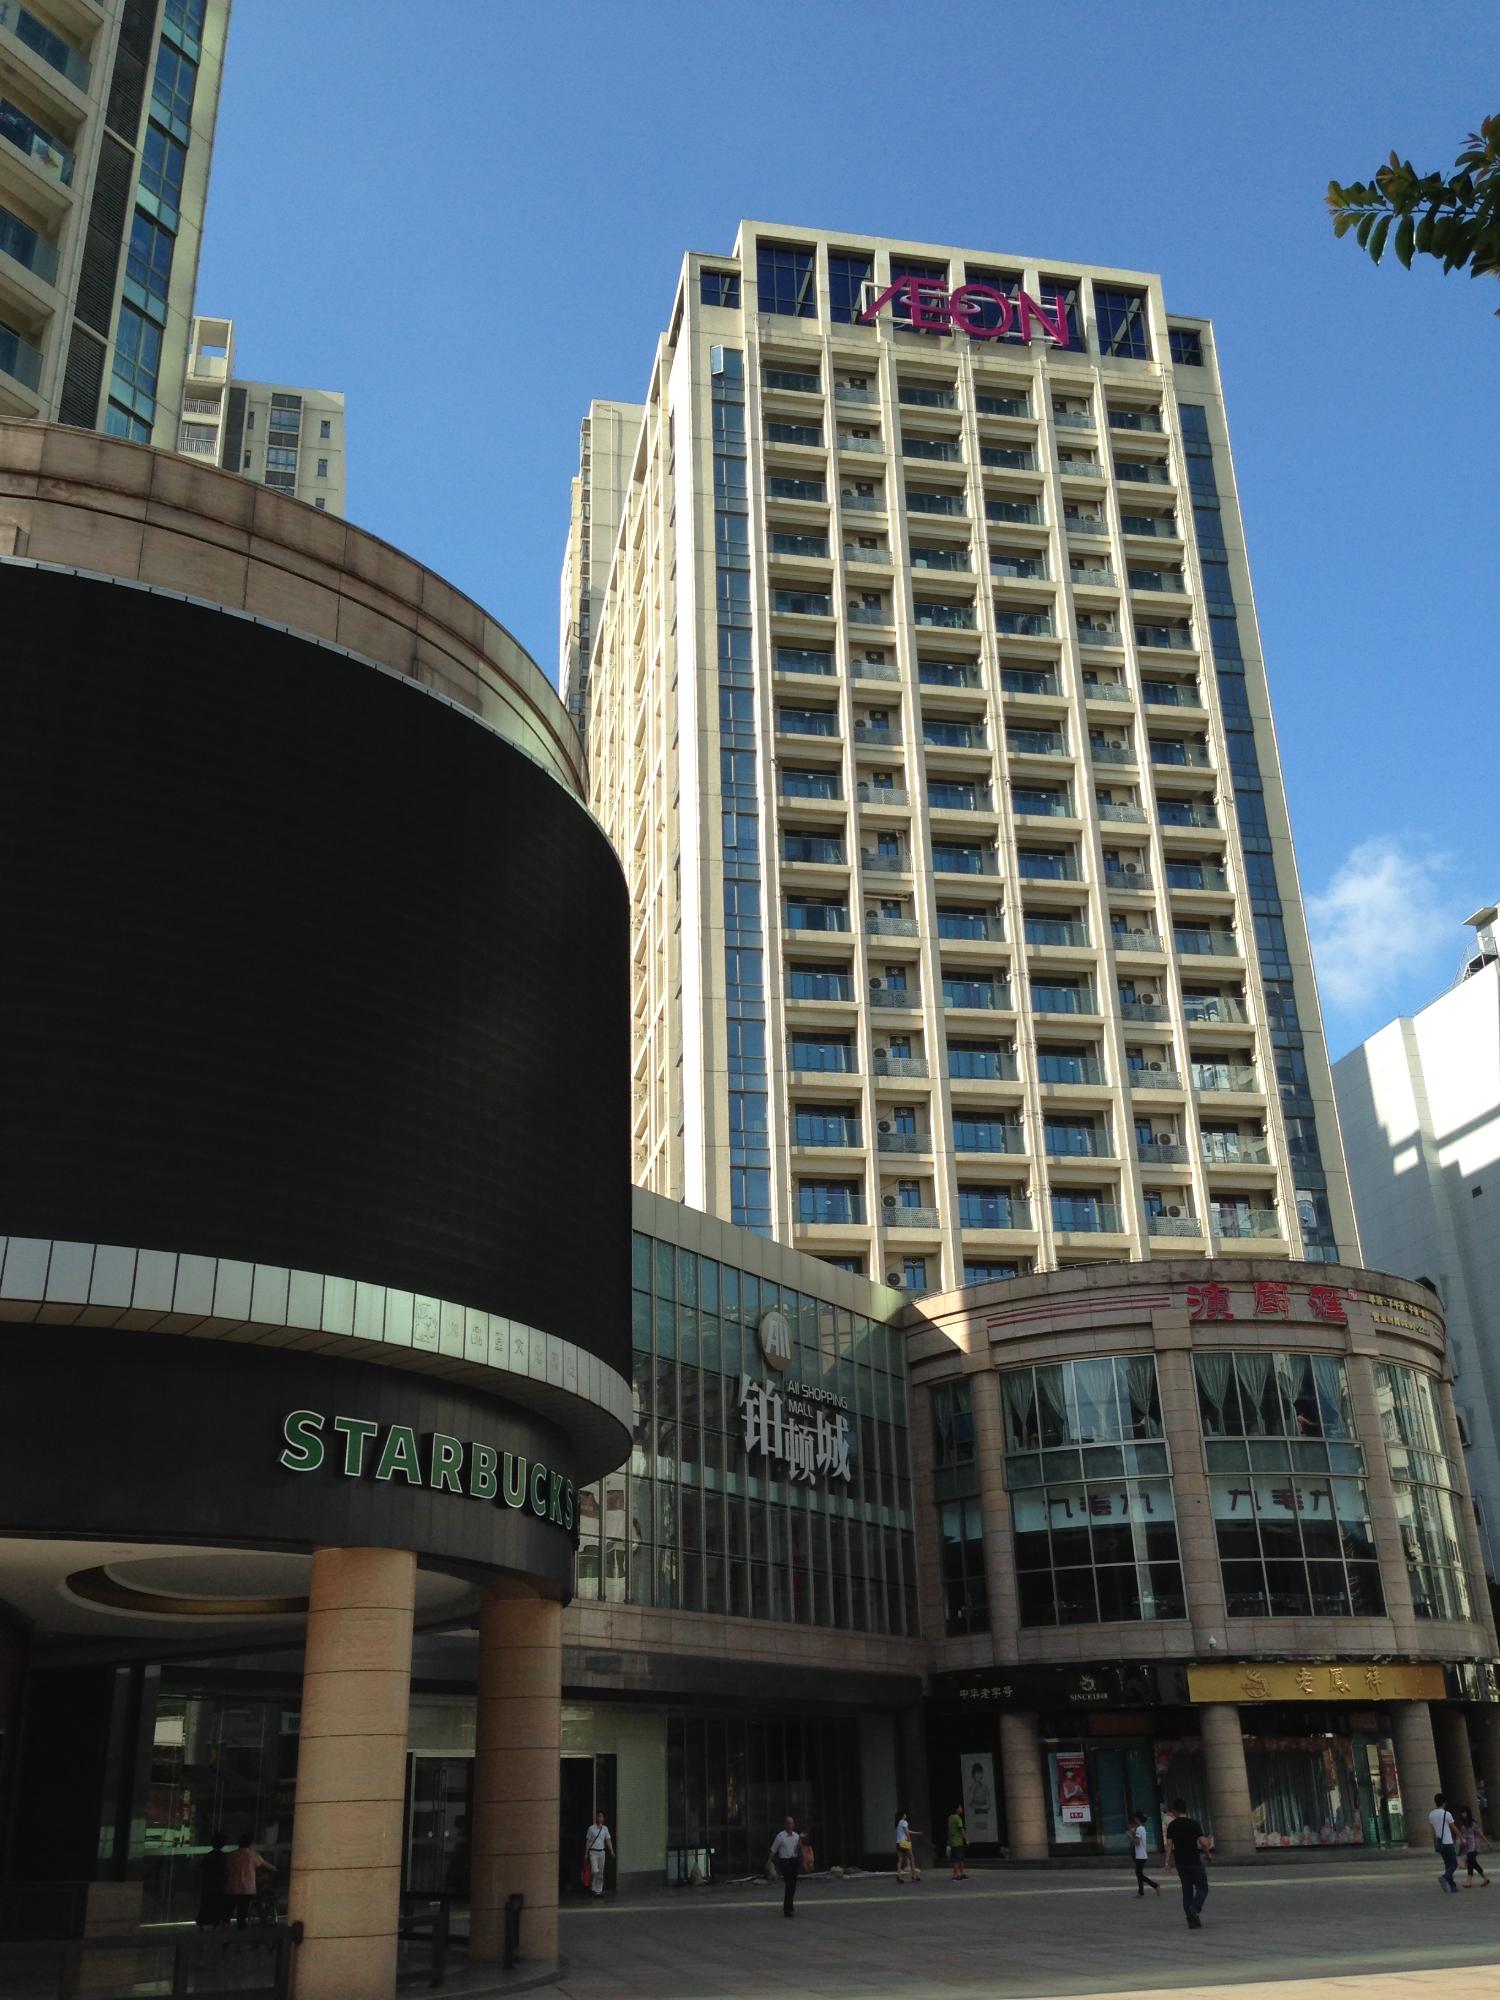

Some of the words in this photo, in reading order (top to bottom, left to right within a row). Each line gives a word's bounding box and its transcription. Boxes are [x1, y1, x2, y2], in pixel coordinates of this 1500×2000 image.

[788, 1400, 814, 1418] MALL
[801, 1384, 848, 1409] SHOPPING
[280, 1410, 574, 1530] STARBUCKS
